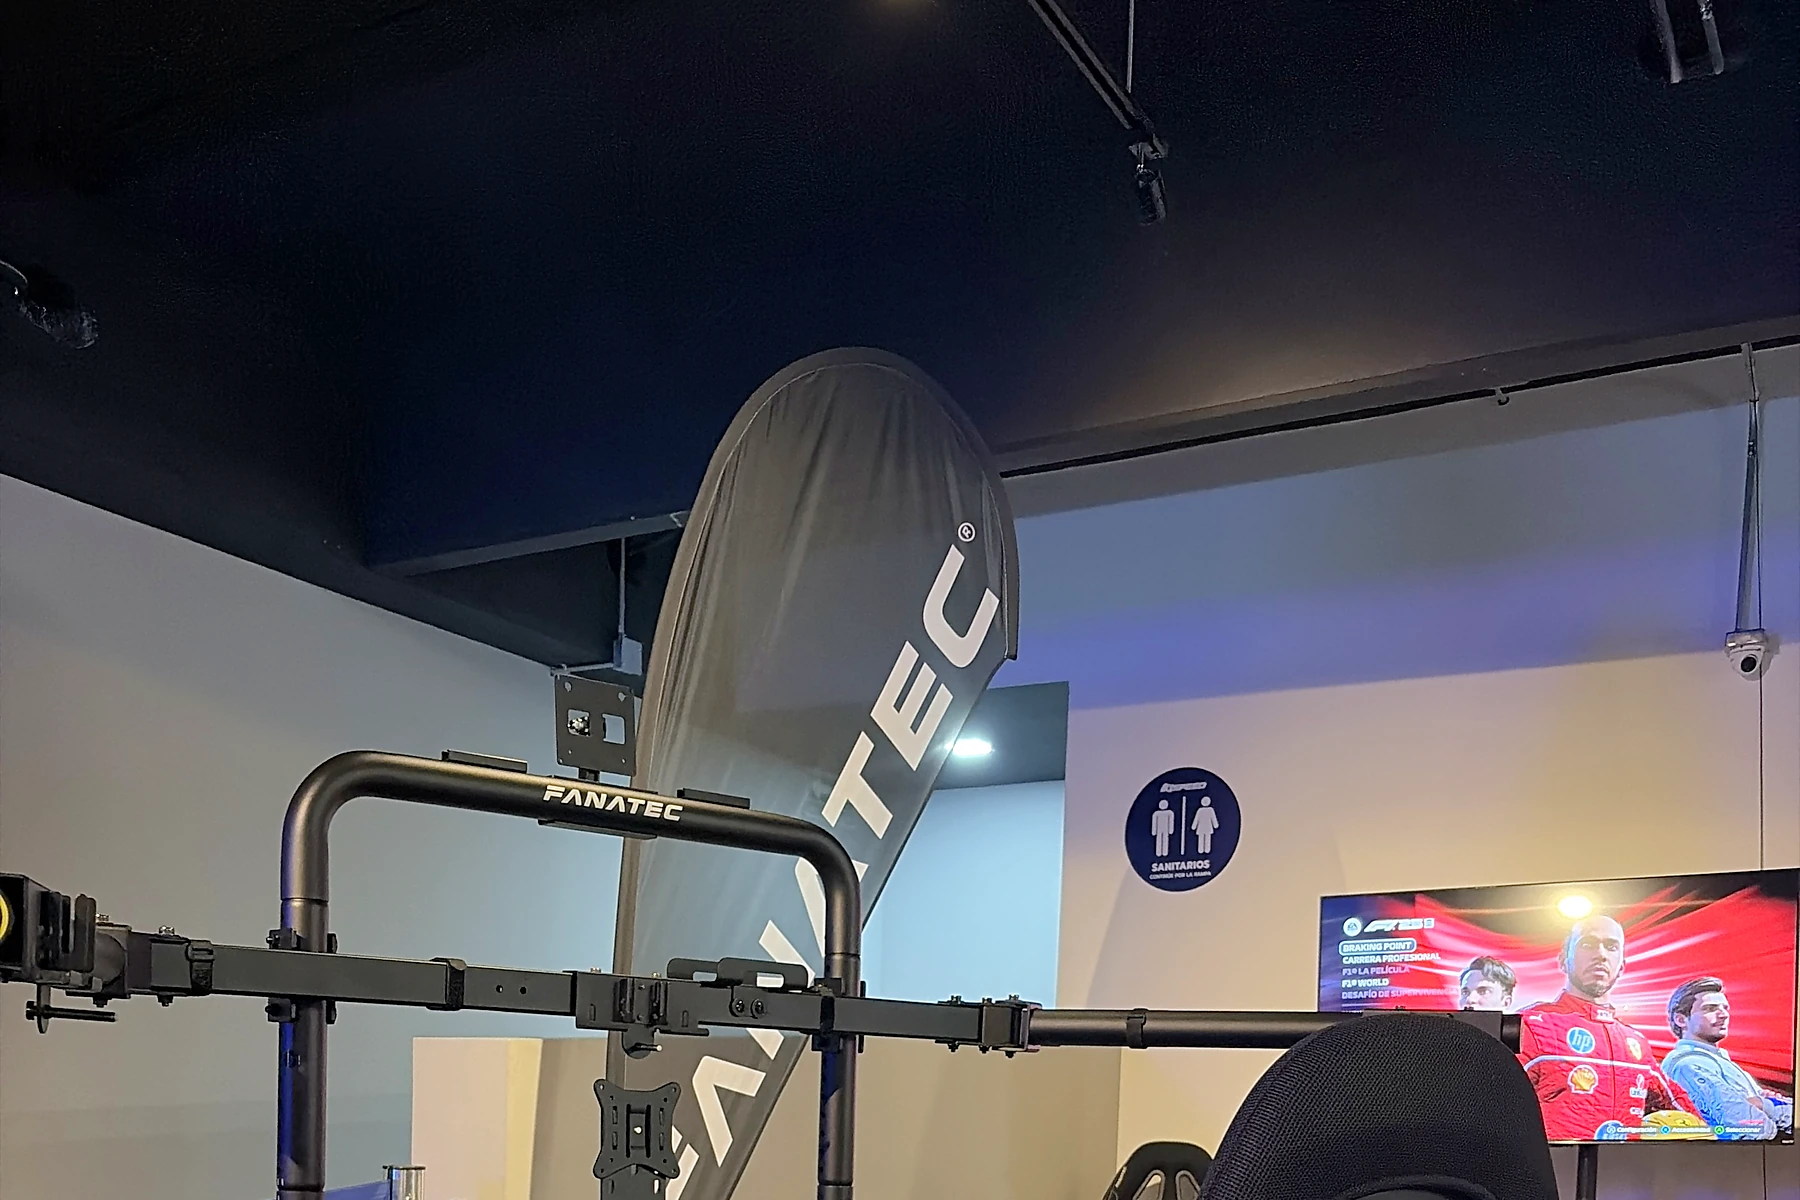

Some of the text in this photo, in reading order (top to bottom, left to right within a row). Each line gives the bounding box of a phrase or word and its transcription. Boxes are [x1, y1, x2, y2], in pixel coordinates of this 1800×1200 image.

[542, 785, 684, 822] FANATEC
[1151, 860, 1211, 872] SANITARIOS
[1343, 941, 1412, 952] BRAKING POINT
[1342, 953, 1441, 964] CARRERA PROFESIONAL
[1357, 978, 1390, 987] WORLD
[1378, 990, 1390, 998] DE
